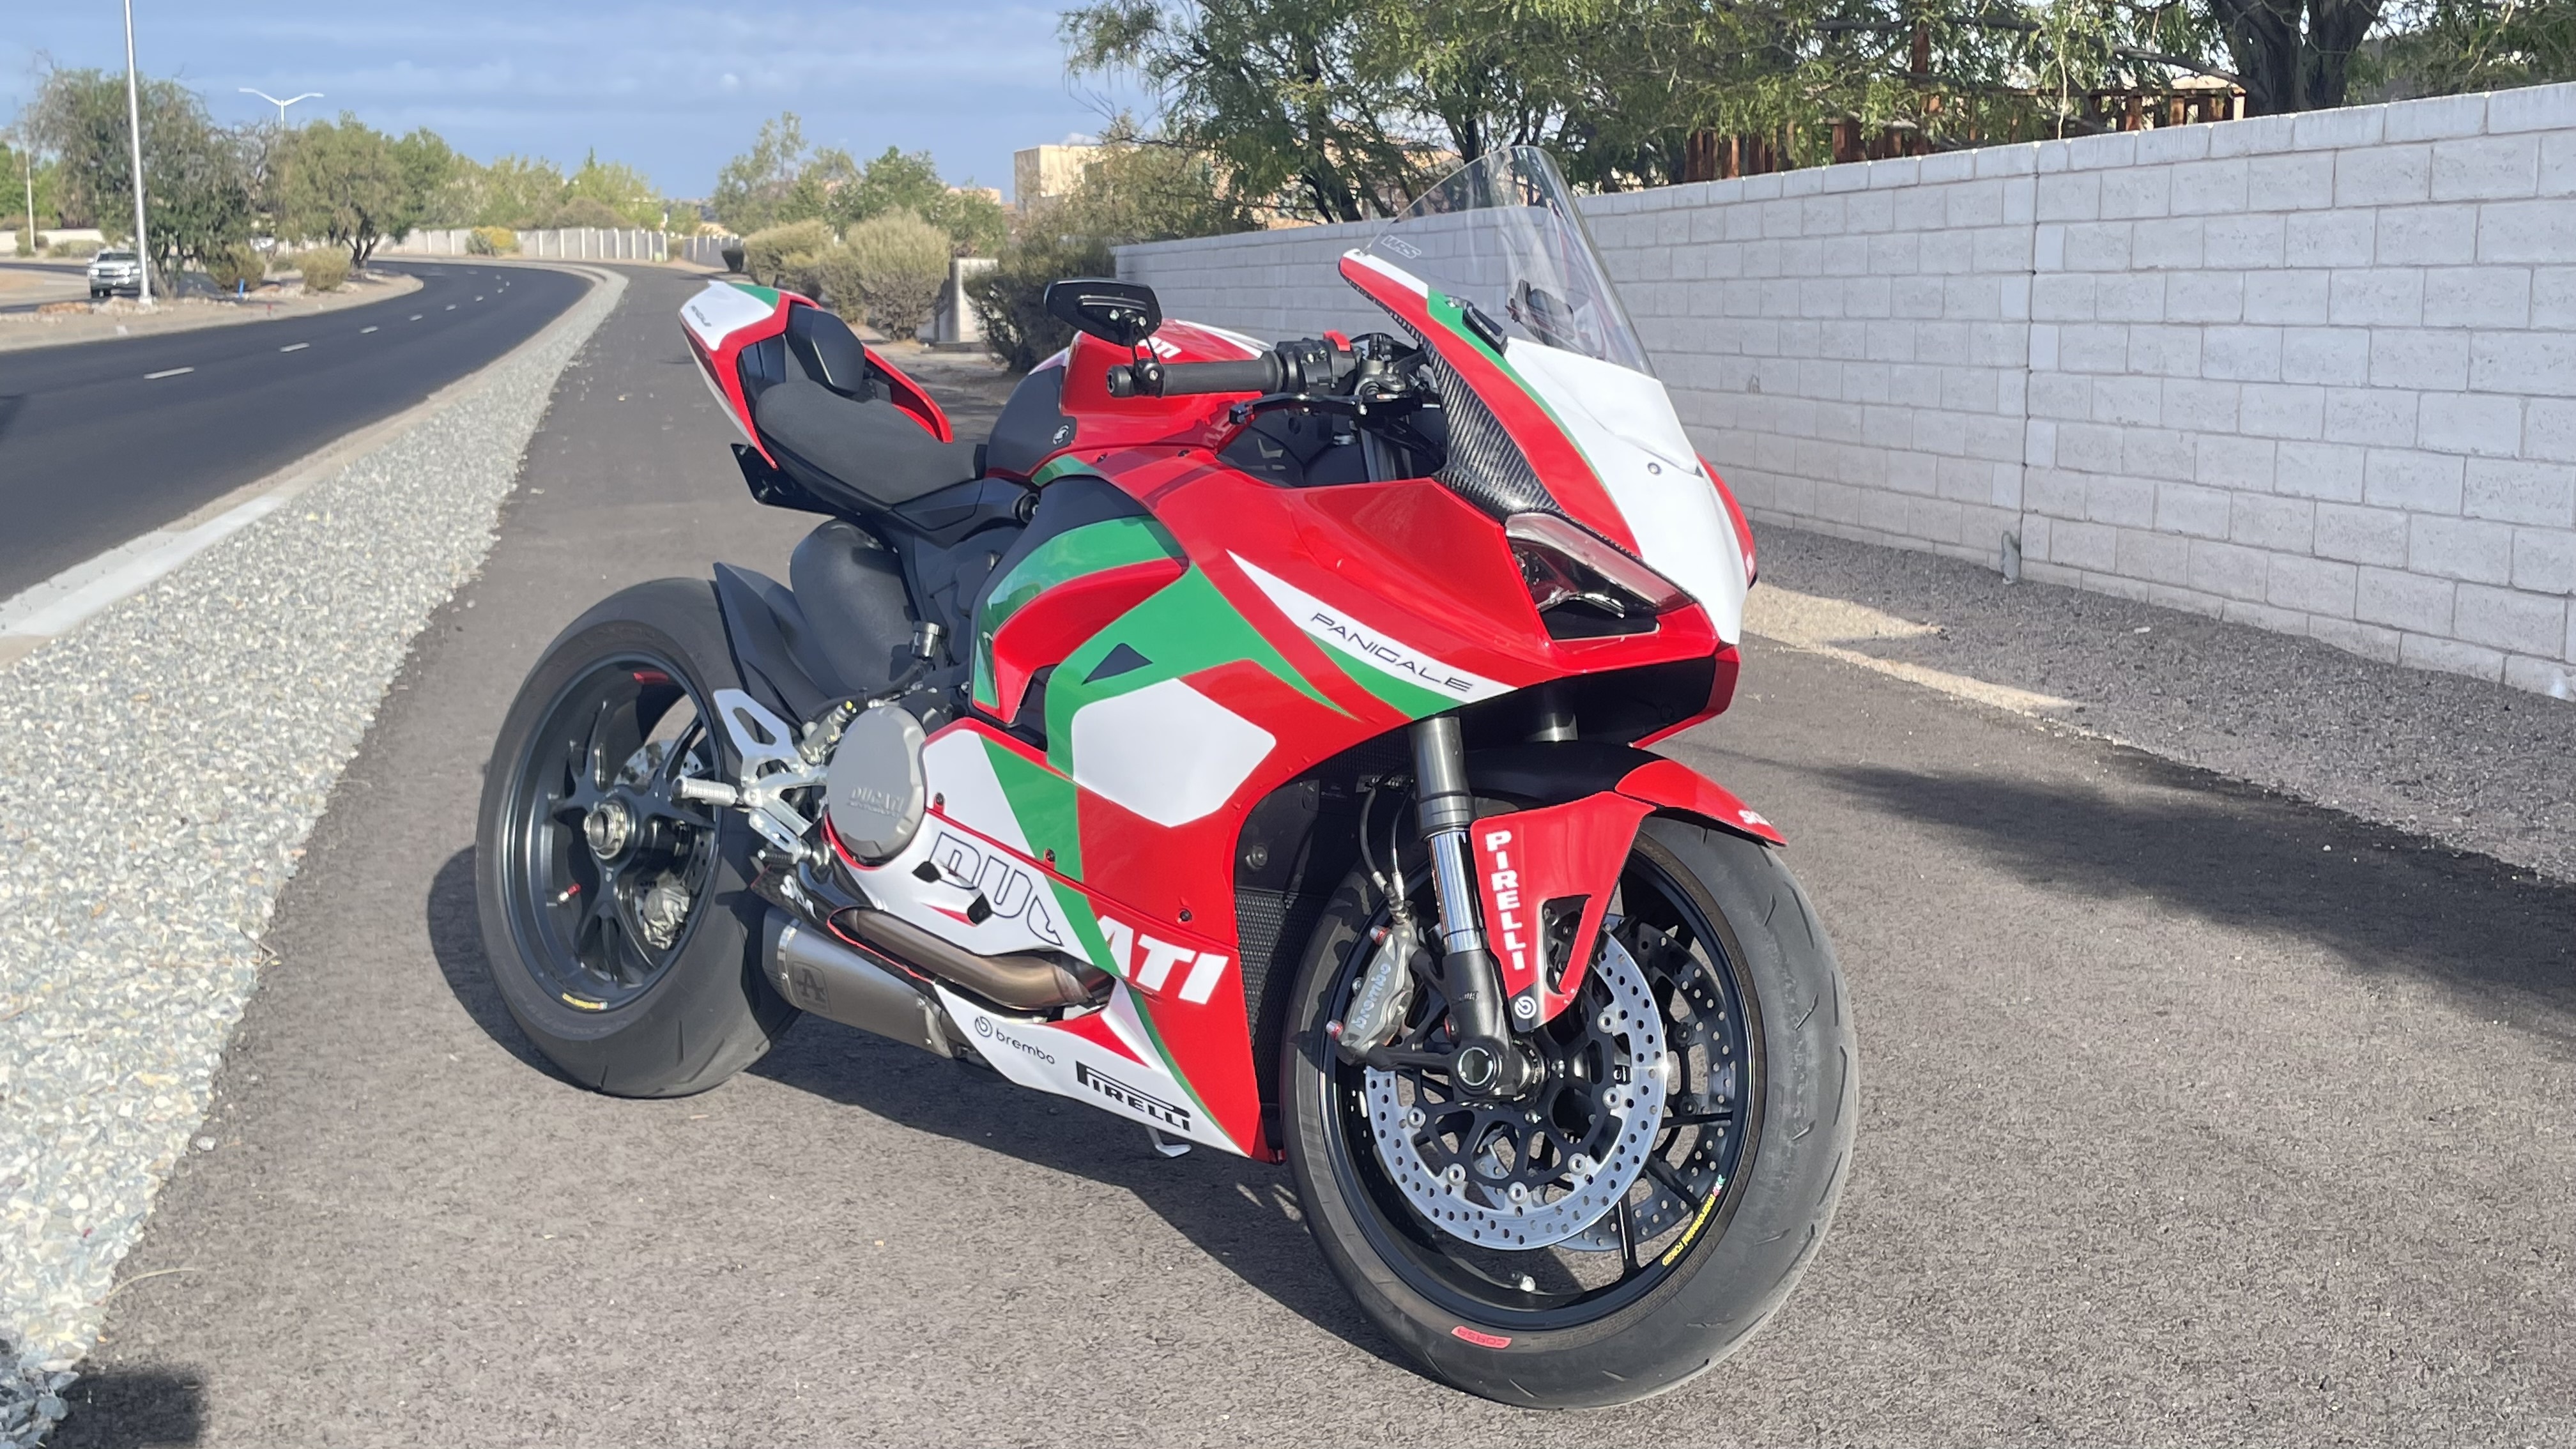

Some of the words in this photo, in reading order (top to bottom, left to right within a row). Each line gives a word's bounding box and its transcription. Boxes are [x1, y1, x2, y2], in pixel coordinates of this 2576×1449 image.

[1310, 613, 1473, 693] PANIGALE
[1485, 830, 1526, 970] PIRELLI
[1351, 963, 1391, 1030] brembo
[995, 1029, 1055, 1065] brembo
[1075, 1061, 1192, 1132] PIRELLI
